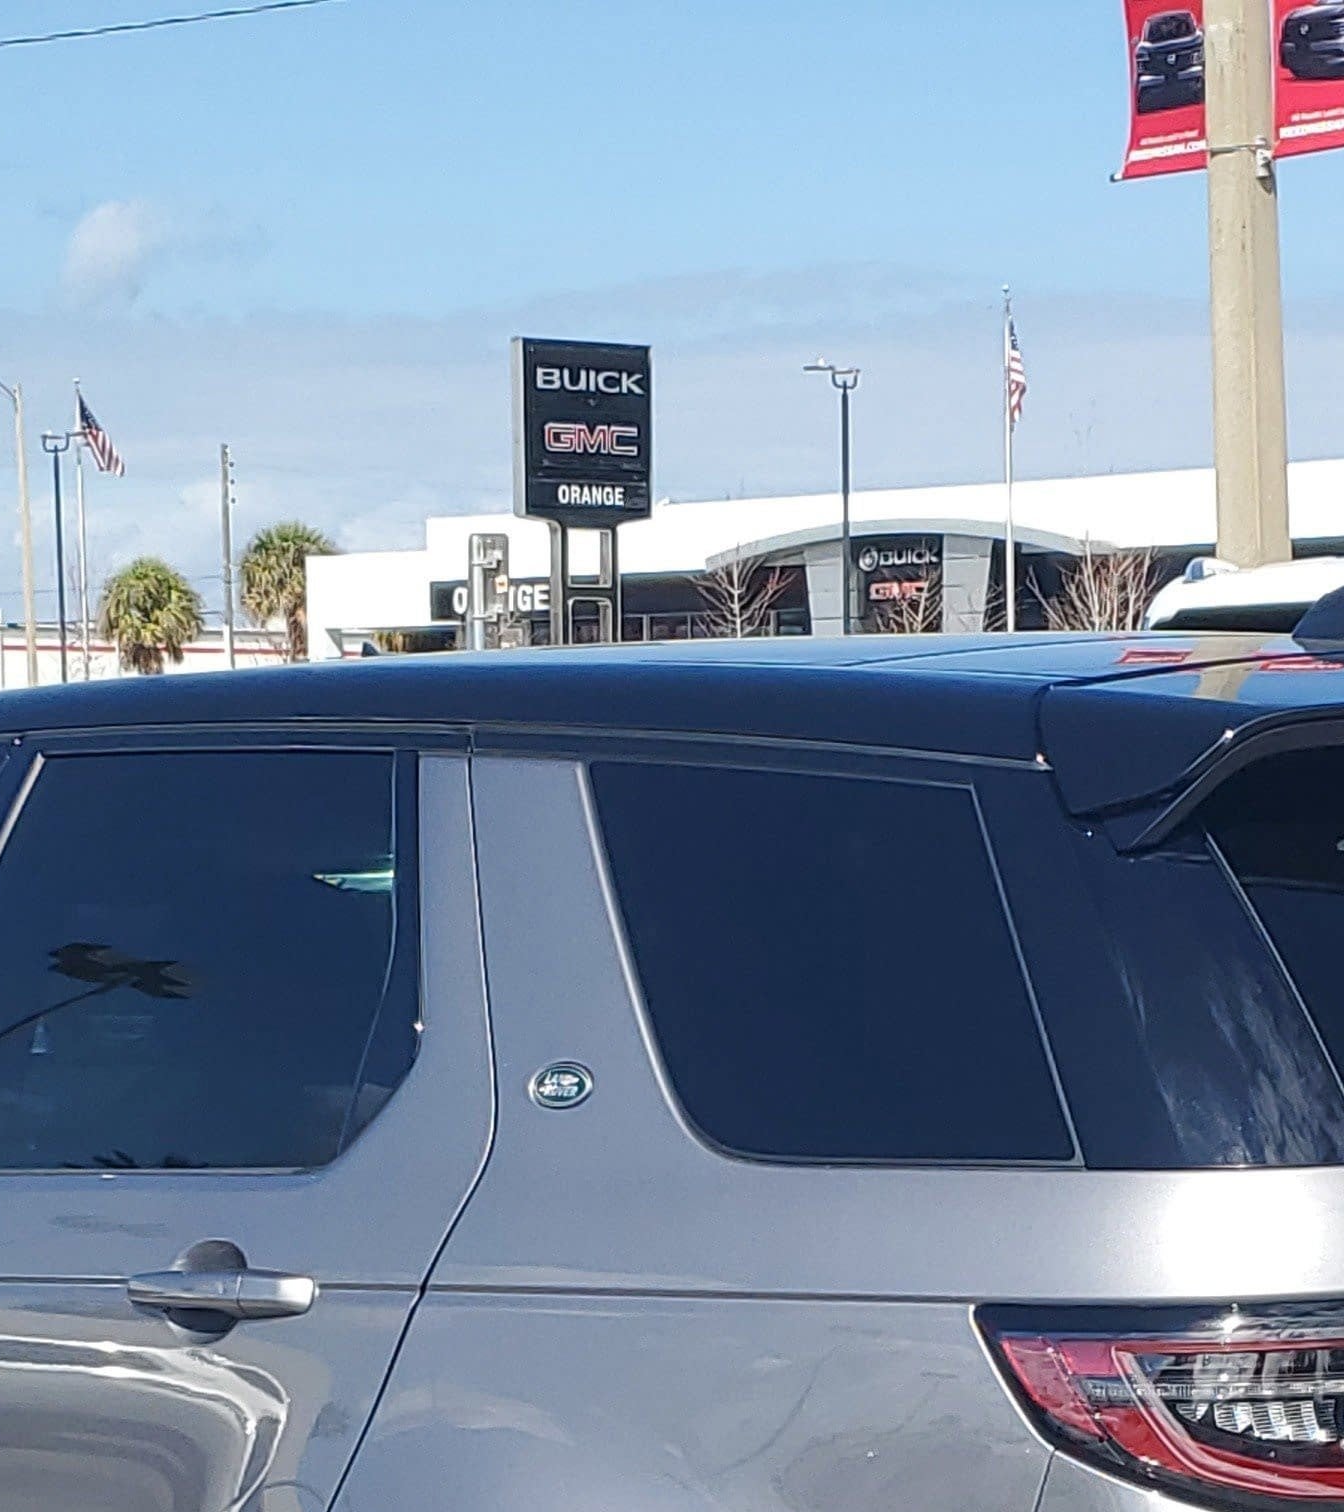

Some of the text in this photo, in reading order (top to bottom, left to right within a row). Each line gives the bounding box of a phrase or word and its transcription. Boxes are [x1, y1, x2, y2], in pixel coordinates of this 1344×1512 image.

[536, 366, 645, 395] BUICK
[544, 422, 638, 456] GMC
[558, 484, 625, 506] ORANGE
[879, 549, 939, 566] BUICK
[453, 584, 550, 614] OGE
